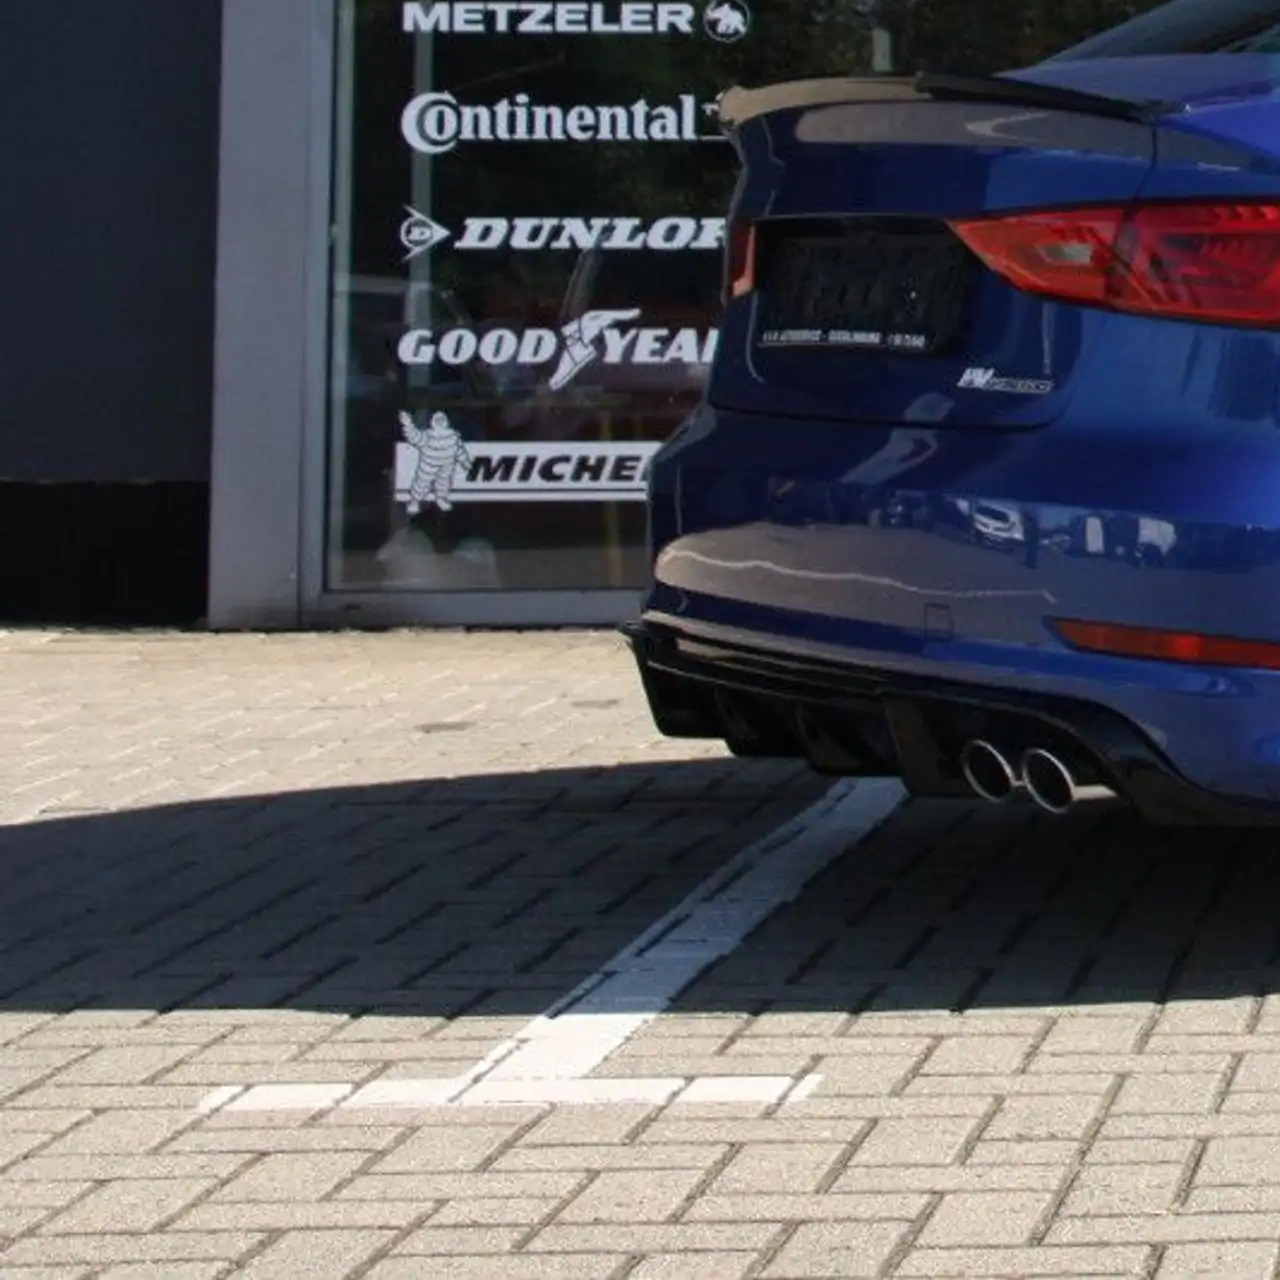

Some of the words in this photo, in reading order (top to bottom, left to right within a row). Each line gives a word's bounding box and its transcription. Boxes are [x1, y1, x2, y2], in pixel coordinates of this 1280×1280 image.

[402, 1, 695, 34] METZELER
[401, 91, 698, 154] Continental
[464, 455, 650, 485] MICHE
